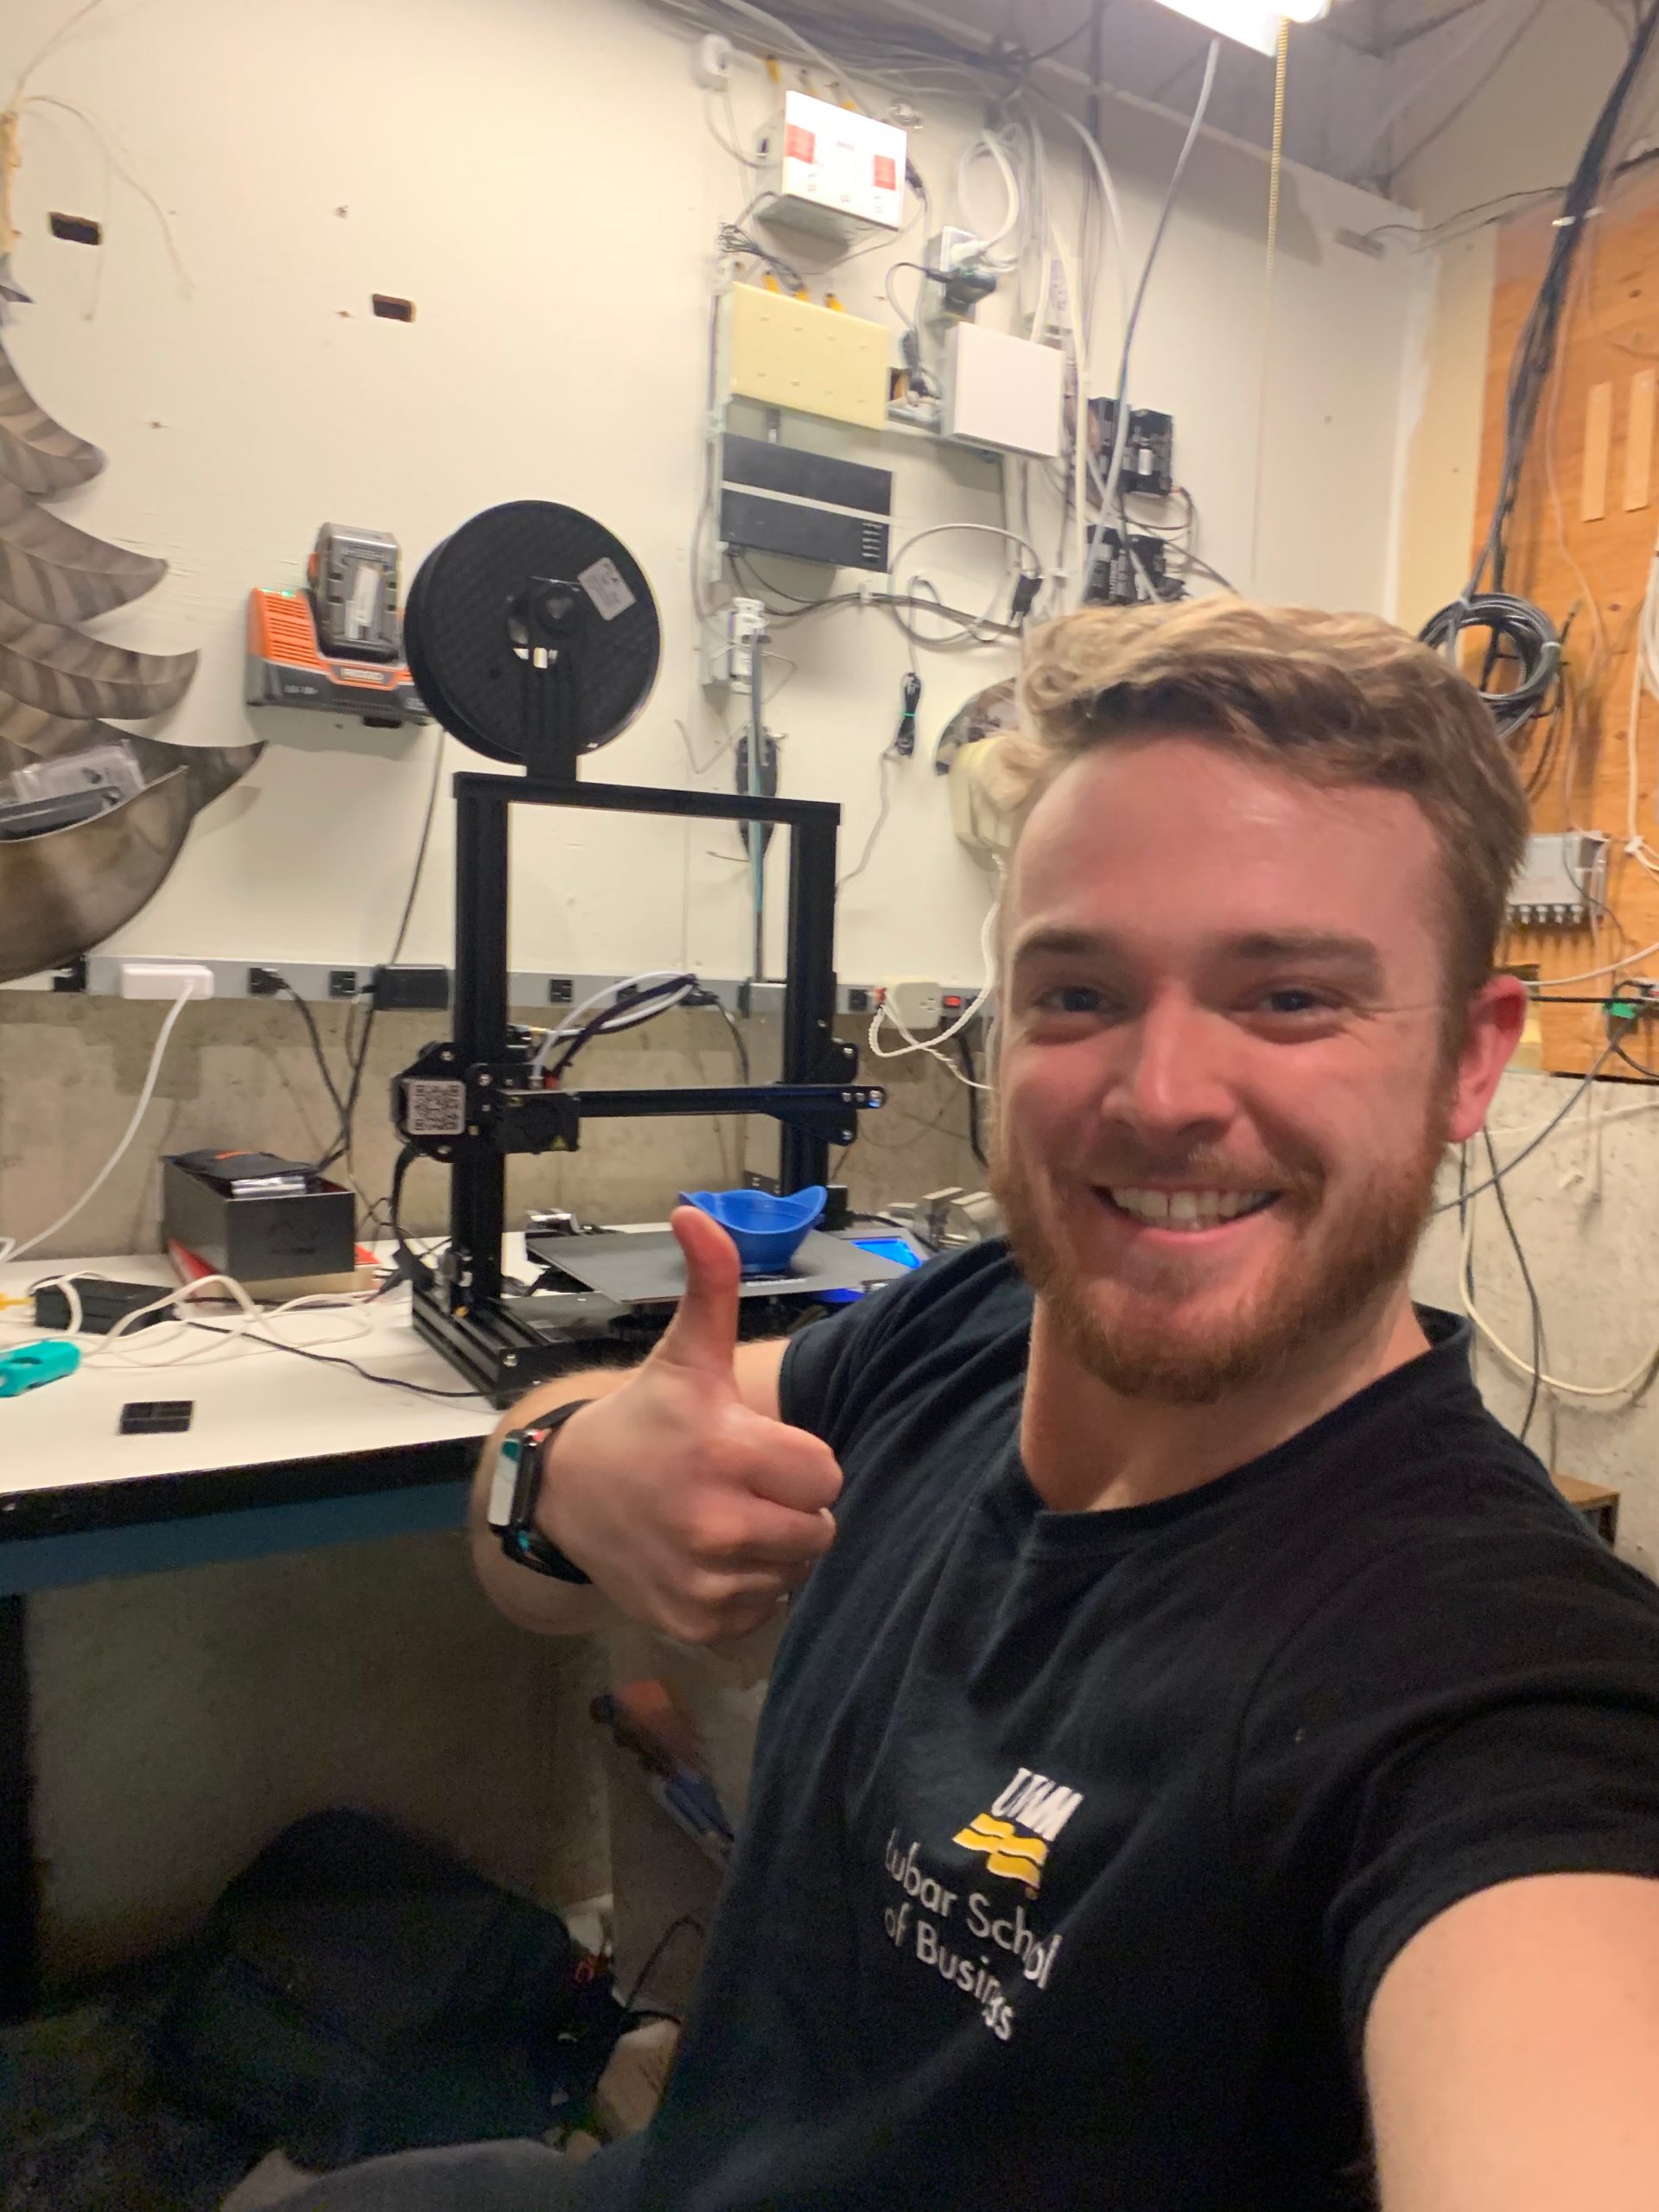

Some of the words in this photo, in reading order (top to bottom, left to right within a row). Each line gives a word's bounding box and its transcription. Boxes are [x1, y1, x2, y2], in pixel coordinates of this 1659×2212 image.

[885, 1826, 958, 1917] Lubar
[966, 1891, 1063, 1989] Schol
[885, 1902, 912, 1946] of
[916, 1919, 1014, 2041] Businss
